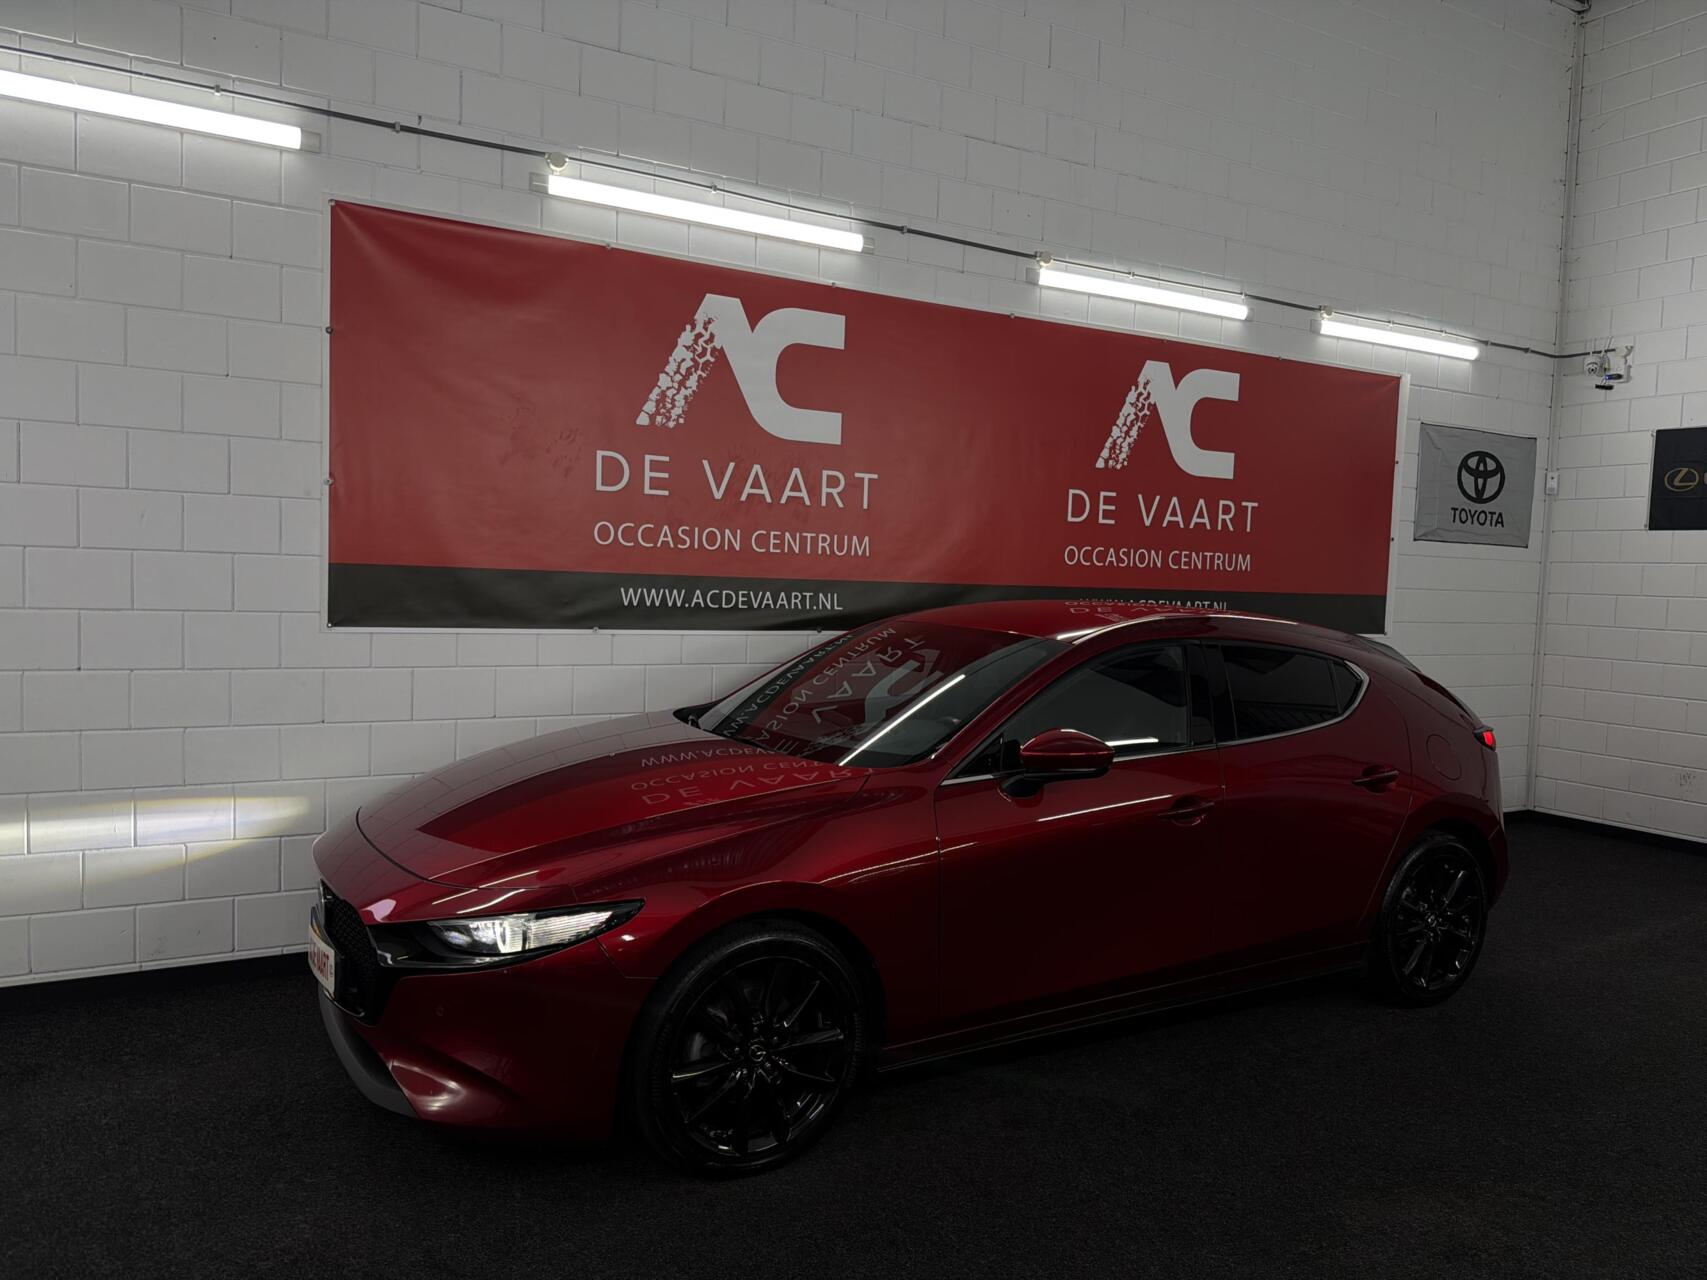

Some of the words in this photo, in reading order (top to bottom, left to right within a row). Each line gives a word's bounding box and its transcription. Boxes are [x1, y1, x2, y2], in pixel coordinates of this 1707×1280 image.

[595, 450, 670, 496] DE
[702, 459, 879, 510] VAART
[1067, 488, 1117, 525] DE
[1137, 493, 1259, 533] VAART
[1451, 507, 1505, 528] TOYOTA
[593, 521, 741, 551] OCCASION
[751, 530, 870, 557] CENTRUM
[1064, 545, 1162, 569] OCCASION
[1168, 550, 1251, 572] CENTRUM
[620, 587, 843, 611] WWW.ACDEVAART.NL
